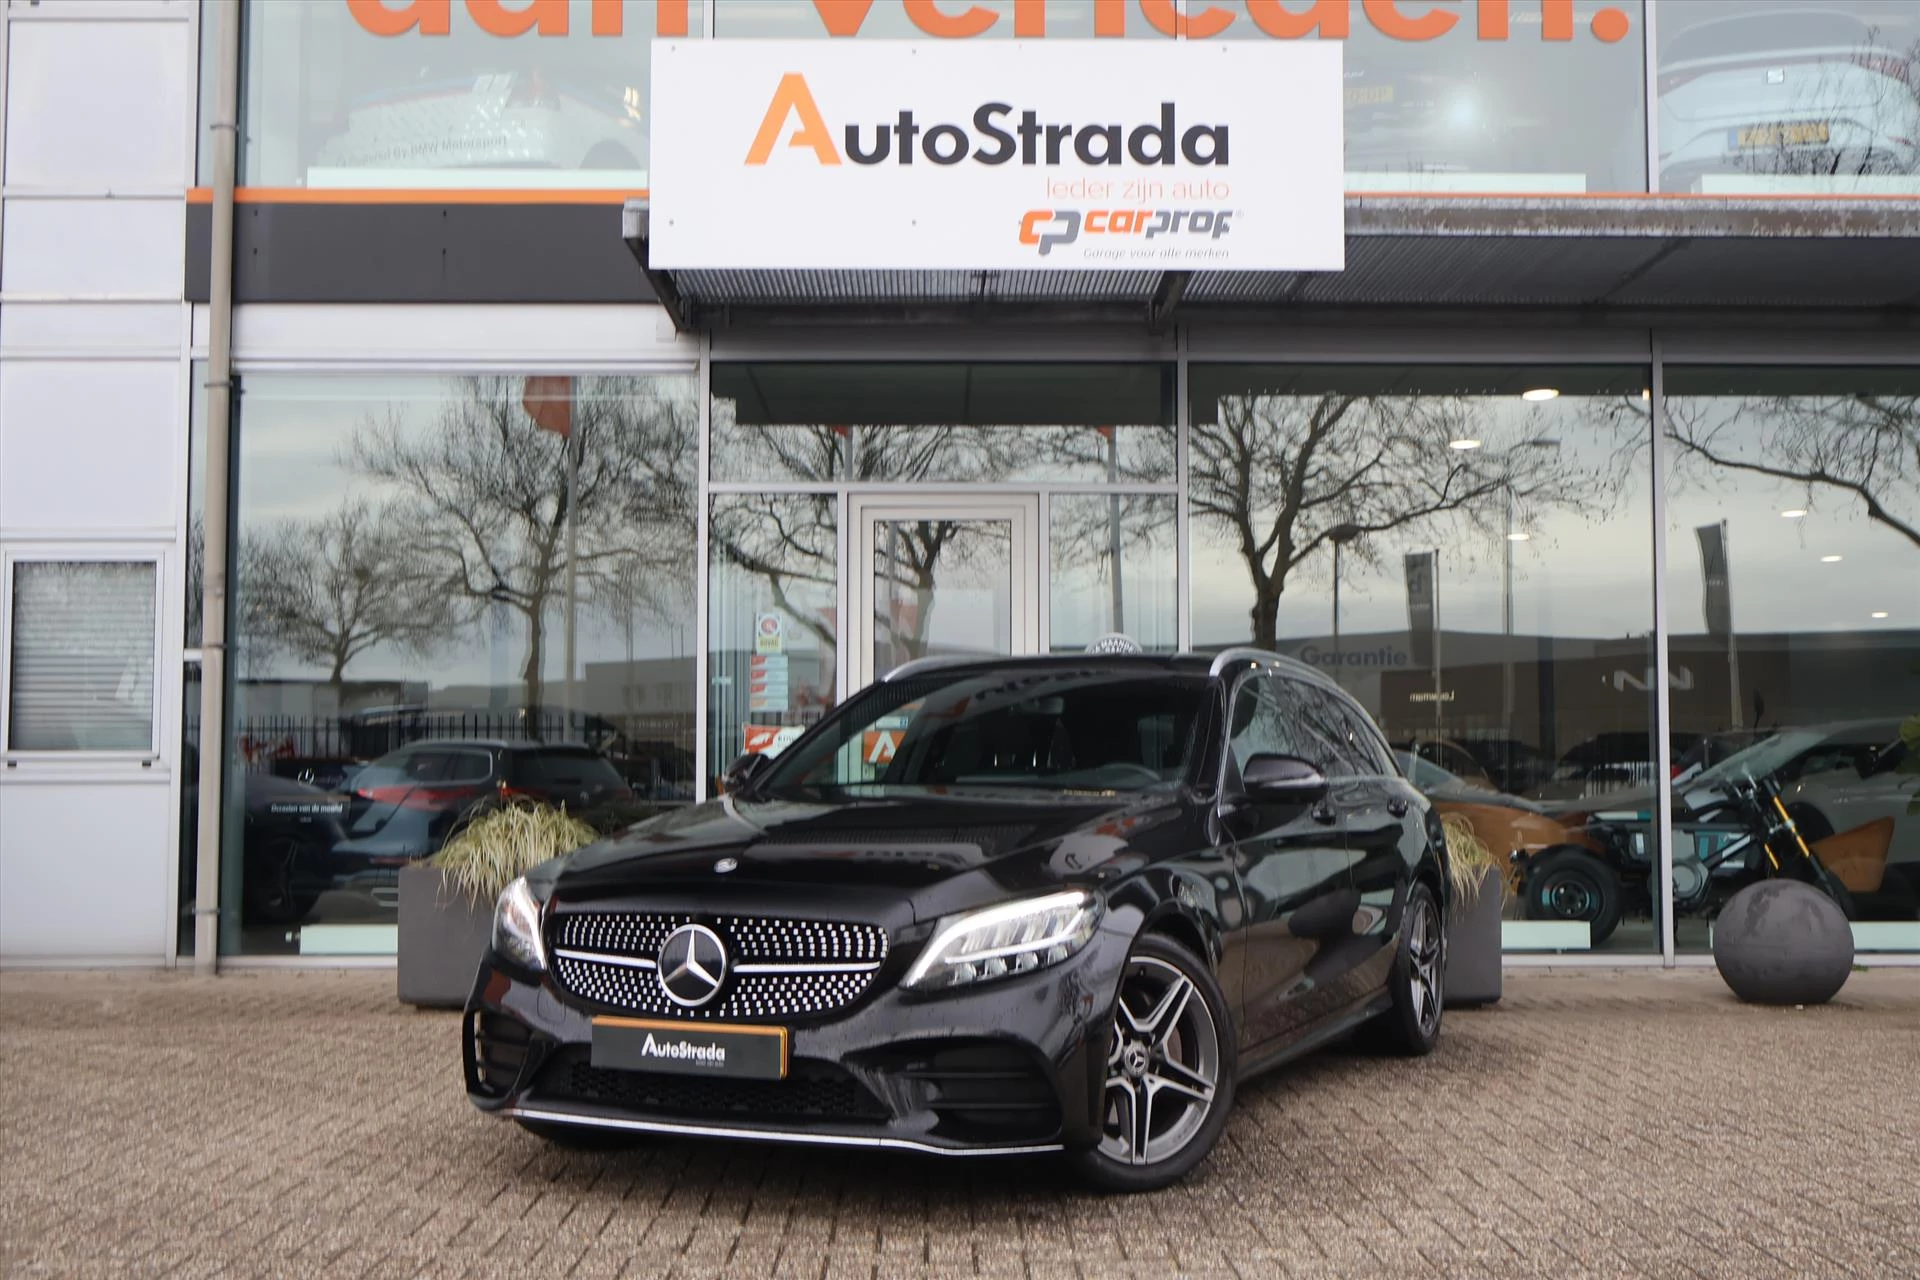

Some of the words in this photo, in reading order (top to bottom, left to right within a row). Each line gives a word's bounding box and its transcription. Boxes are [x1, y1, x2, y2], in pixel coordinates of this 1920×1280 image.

[743, 72, 1229, 165] AutoStrada
[1122, 178, 1163, 204] zijn
[1172, 178, 1230, 199] auto
[1084, 247, 1125, 260] Garage
[1130, 248, 1156, 259] voor
[1160, 247, 1182, 259] alle
[1185, 247, 1230, 259] merken
[1300, 645, 1407, 667] Garantie
[641, 1032, 726, 1061] AutoStrada
